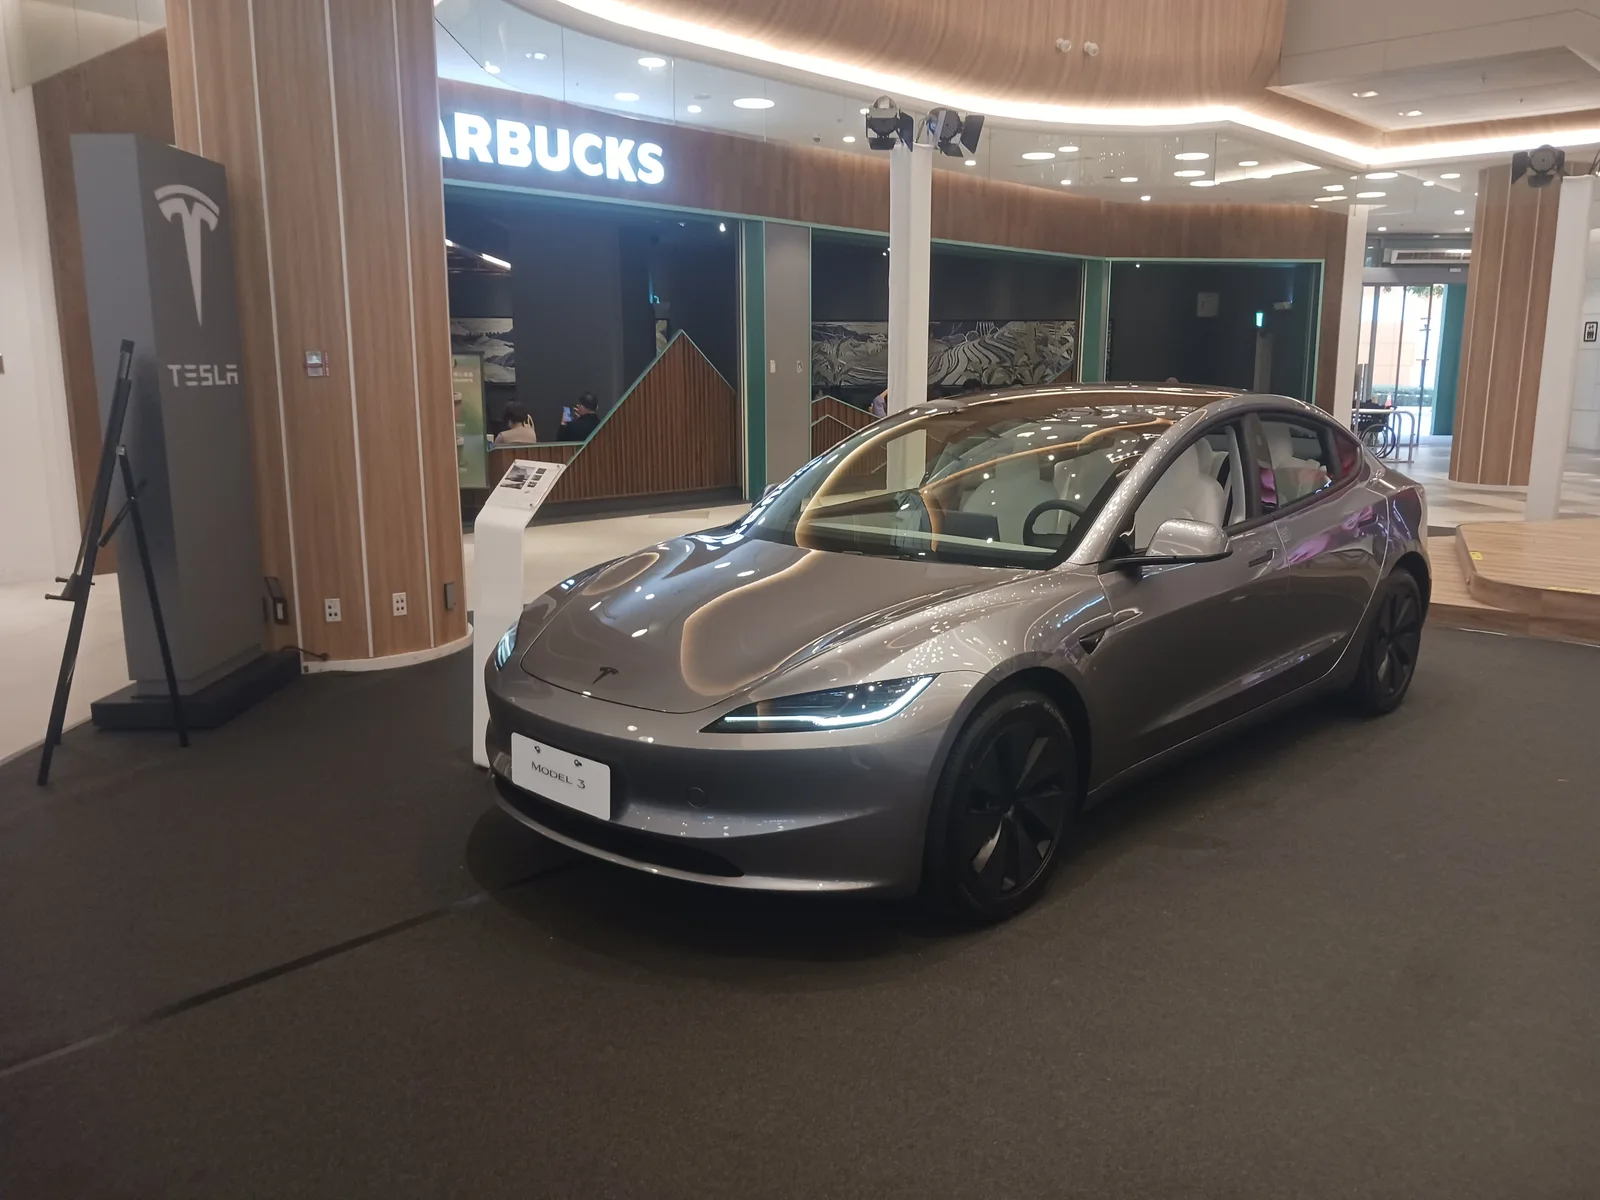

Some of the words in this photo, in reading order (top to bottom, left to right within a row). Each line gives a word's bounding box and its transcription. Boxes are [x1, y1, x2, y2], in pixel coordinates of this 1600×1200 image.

[167, 364, 239, 387] TESLA
[531, 761, 573, 785] MODEL
[577, 778, 586, 789] 3
